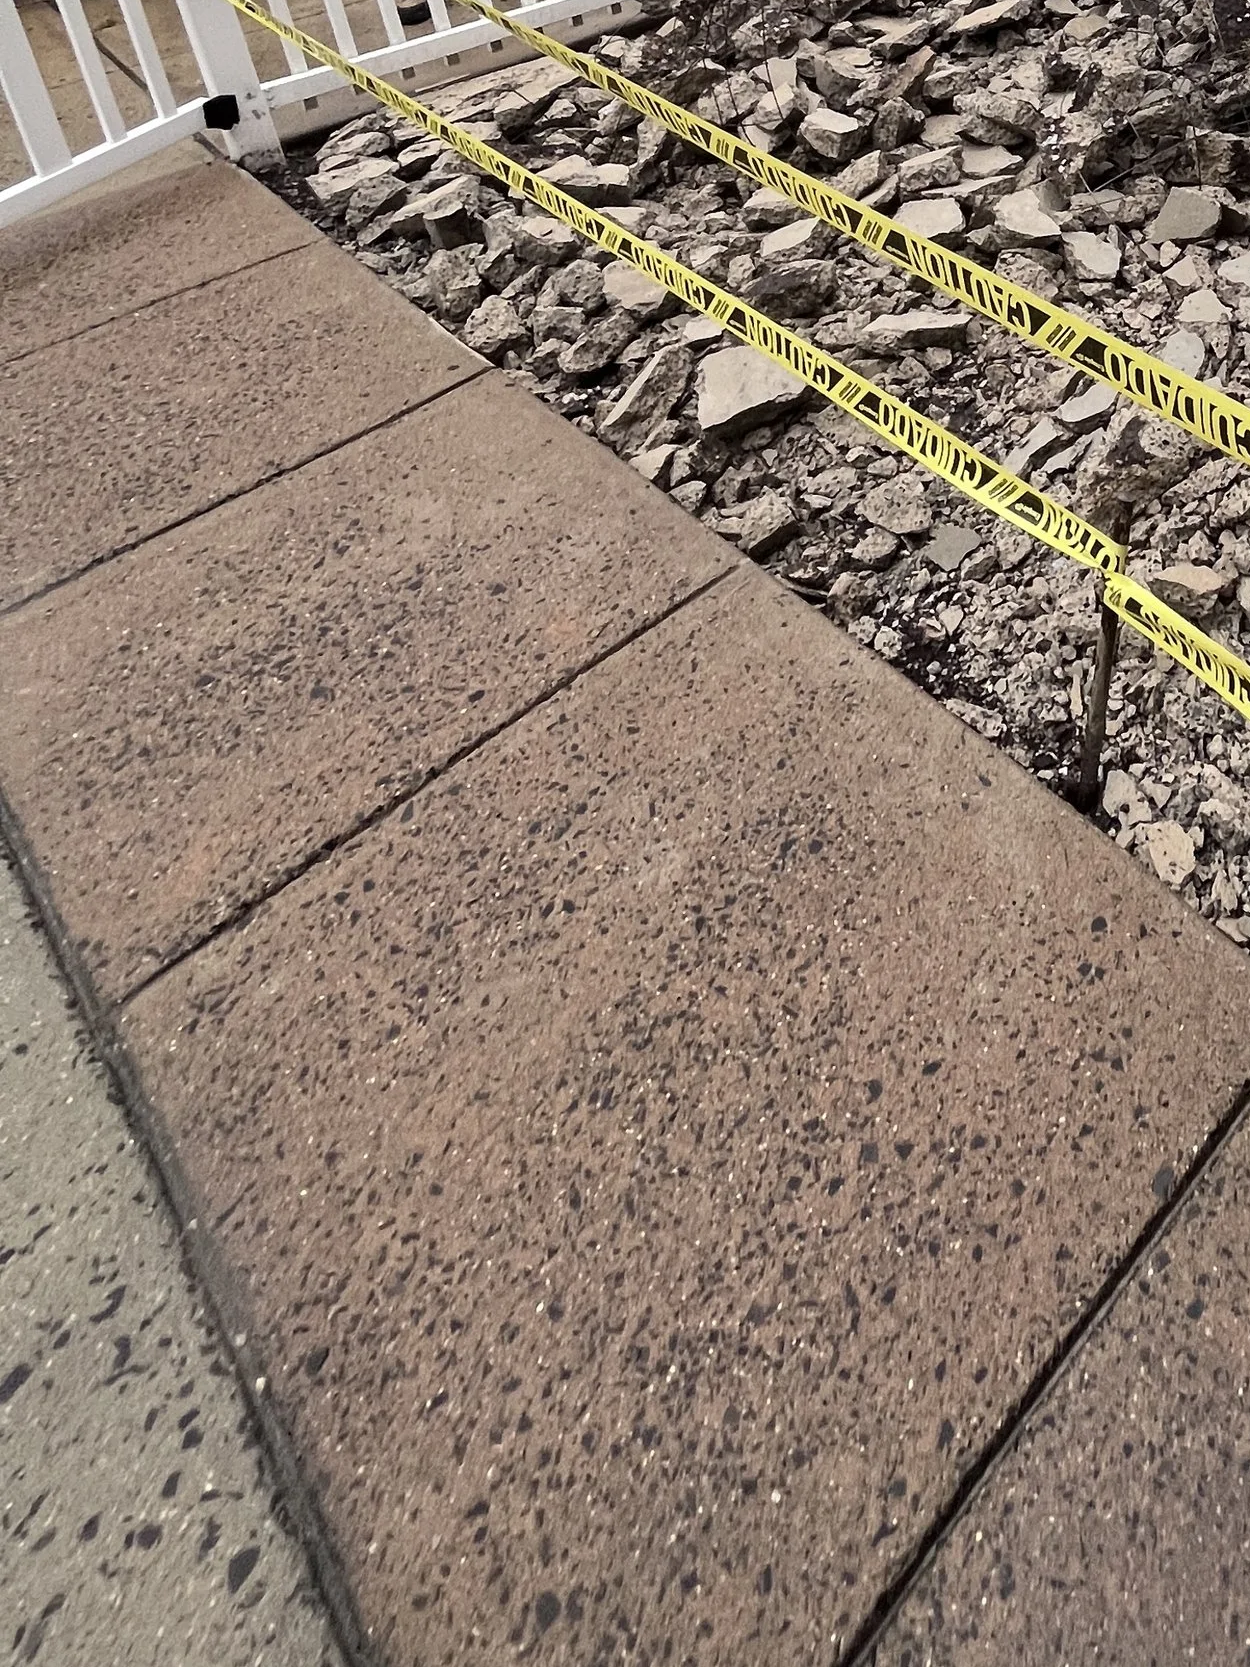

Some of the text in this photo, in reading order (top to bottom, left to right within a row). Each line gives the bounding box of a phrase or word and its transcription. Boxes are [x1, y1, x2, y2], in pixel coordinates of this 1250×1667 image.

[746, 151, 847, 228] CUIDADO
[907, 236, 1026, 330] CAUTION
[744, 311, 827, 389] CAUTION
[879, 398, 978, 487] CUIDADO
